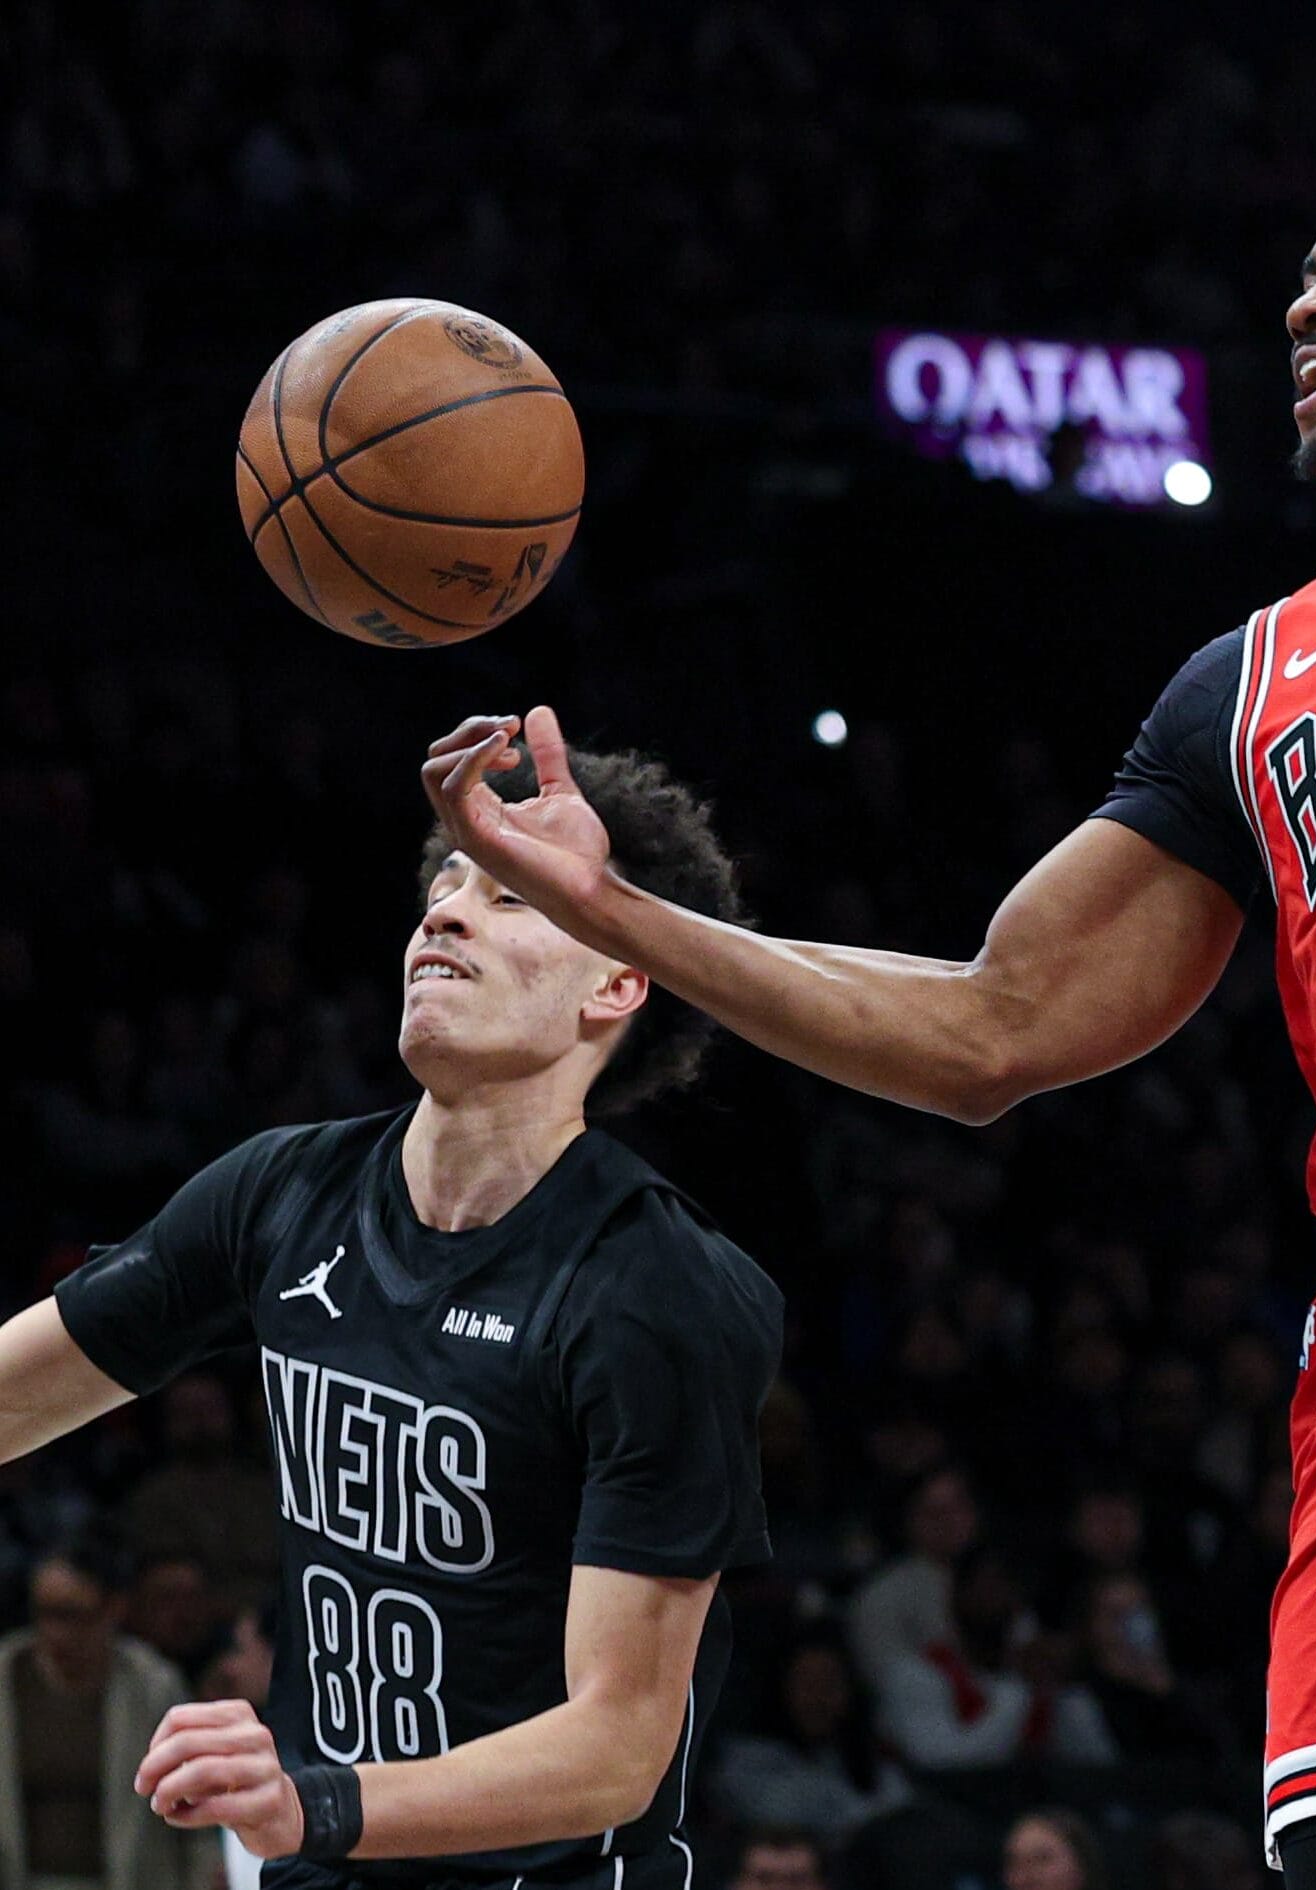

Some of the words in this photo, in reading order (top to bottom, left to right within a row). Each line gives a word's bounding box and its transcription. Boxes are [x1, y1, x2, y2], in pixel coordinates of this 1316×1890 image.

[886, 332, 1188, 441] QATAR
[441, 1307, 469, 1336] All
[465, 1311, 482, 1339] In
[481, 1313, 515, 1343] Won
[261, 1345, 494, 1574] NETS
[302, 1564, 449, 1765] 88
